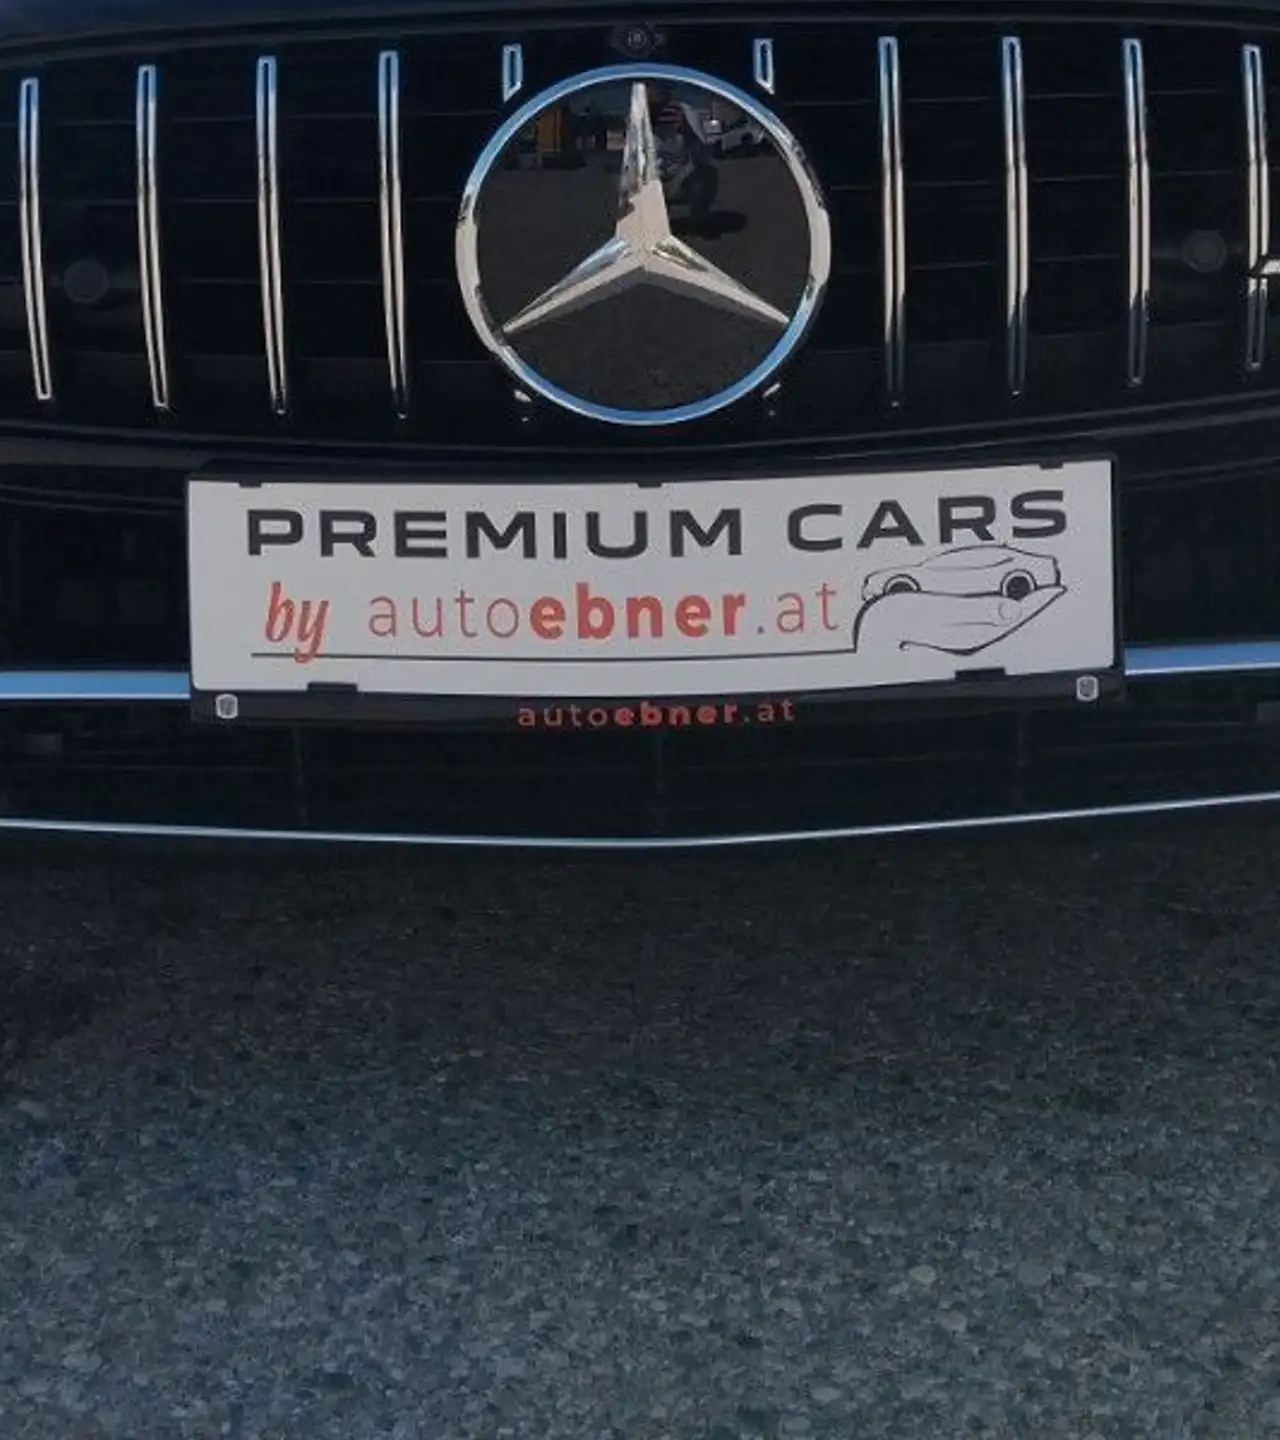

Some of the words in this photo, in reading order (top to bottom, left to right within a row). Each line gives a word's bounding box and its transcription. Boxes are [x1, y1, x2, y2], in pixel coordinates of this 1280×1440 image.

[247, 508, 742, 559] PREMIUM
[786, 489, 1068, 551] CARS
[265, 581, 329, 663] by
[368, 580, 839, 641] autoebner.at
[518, 699, 797, 727] autoebner.at
